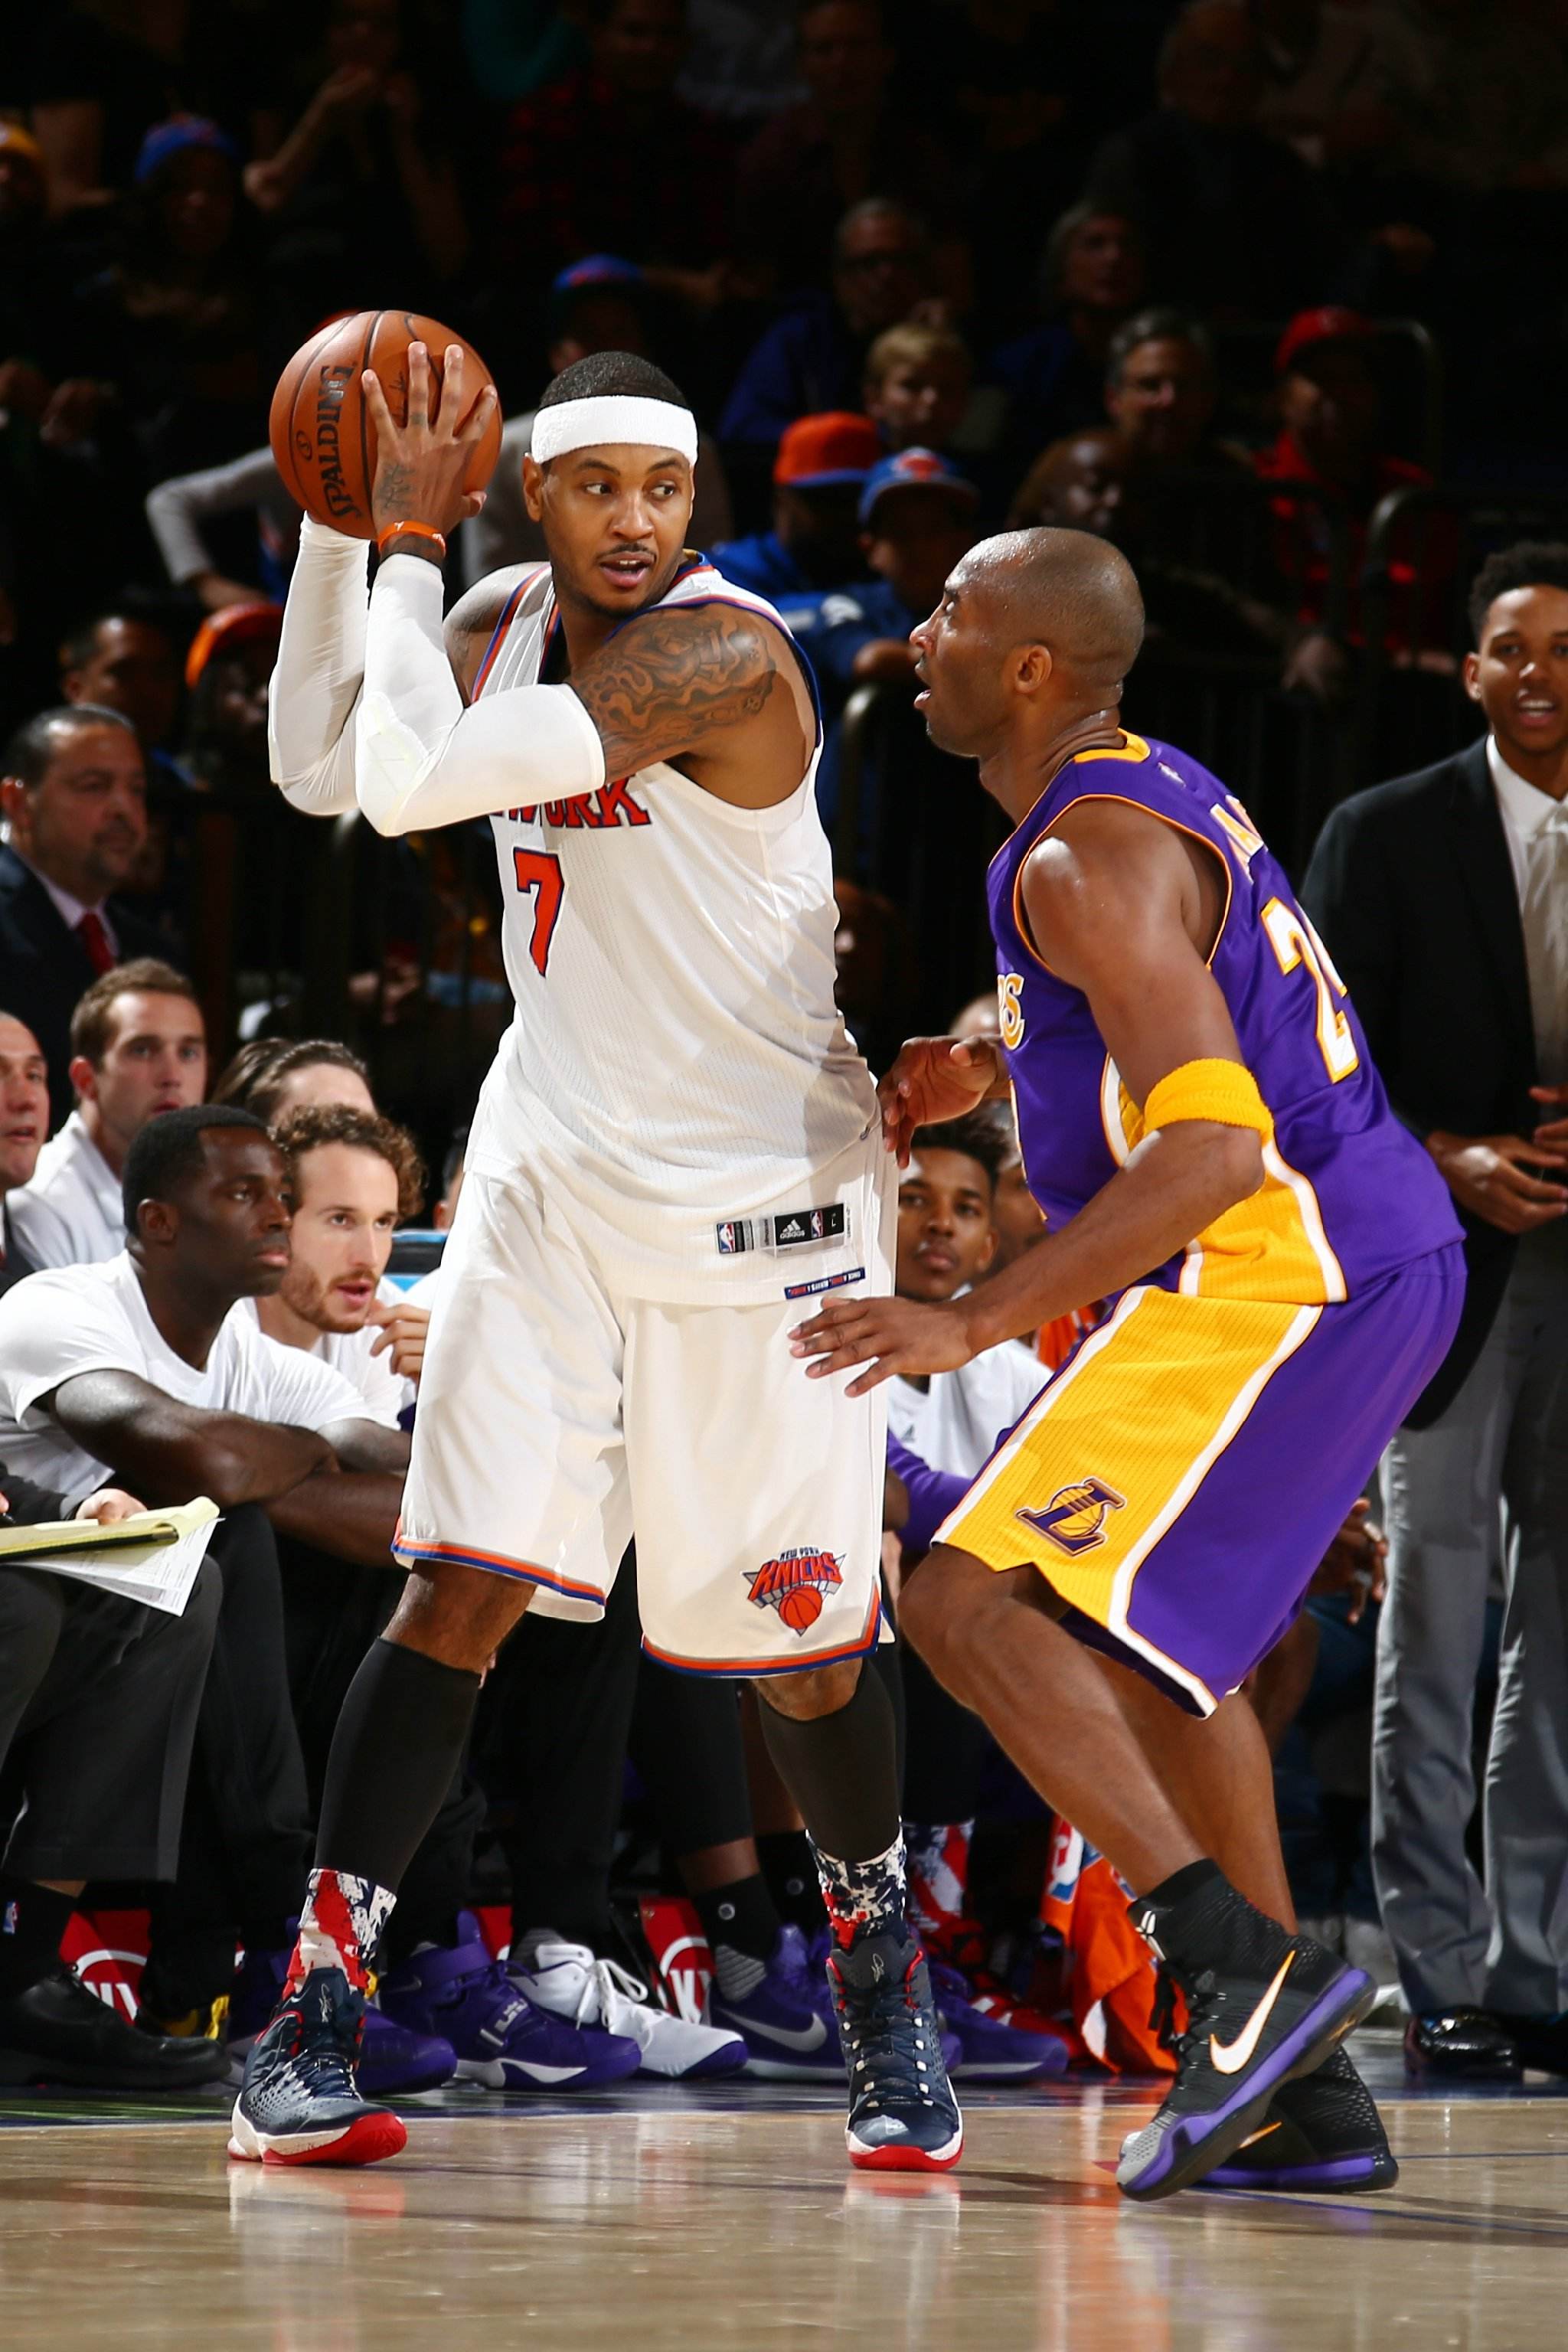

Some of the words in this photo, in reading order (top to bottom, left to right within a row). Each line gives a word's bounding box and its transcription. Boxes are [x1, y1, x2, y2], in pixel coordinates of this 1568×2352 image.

[317, 365, 361, 519] SPALDING
[539, 775, 652, 828] ORK
[513, 846, 565, 978] 7
[1261, 896, 1360, 1084] 2
[779, 1230, 805, 1239] adidas
[748, 1551, 844, 1602] KNICKS
[779, 1547, 798, 1561] NEW
